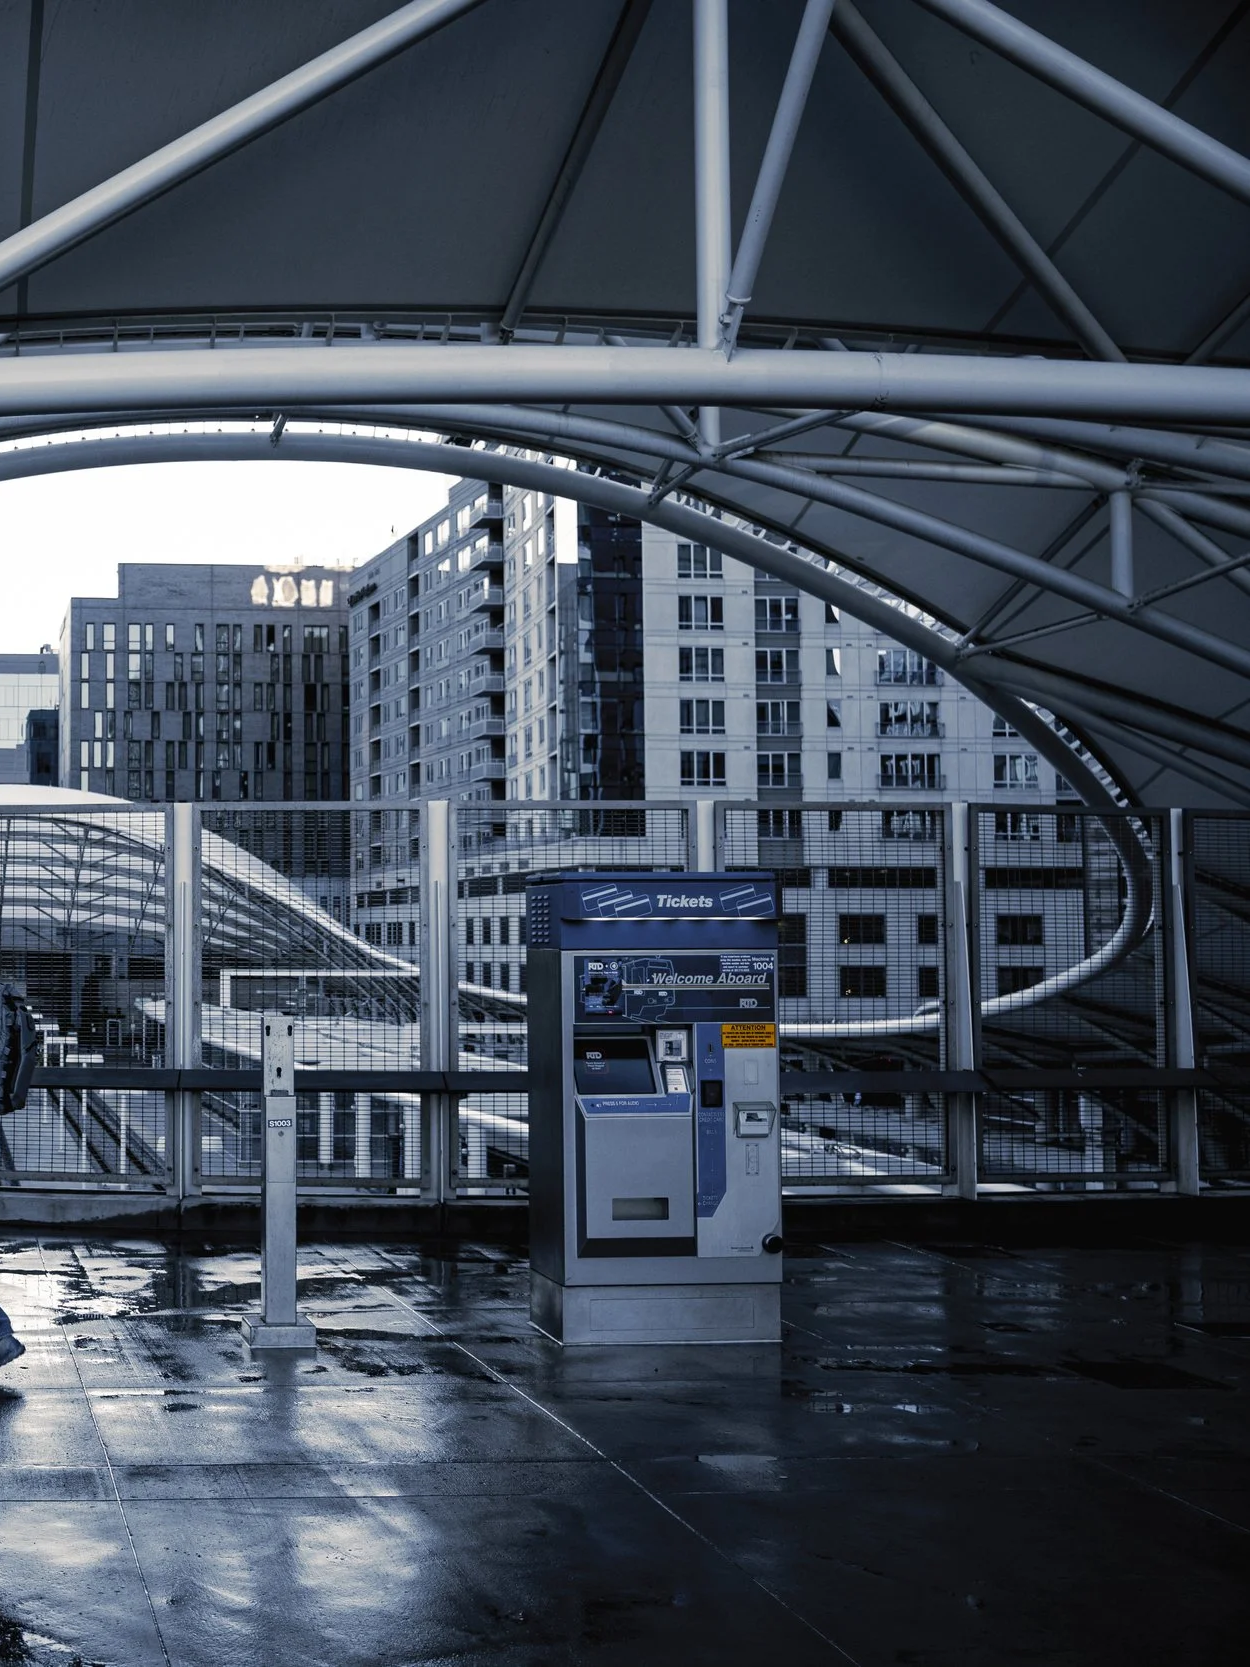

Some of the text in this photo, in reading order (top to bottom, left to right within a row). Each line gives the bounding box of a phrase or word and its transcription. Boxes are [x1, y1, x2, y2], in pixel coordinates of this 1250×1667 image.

[656, 894, 714, 908] Tickets
[588, 962, 604, 971] RTD
[752, 961, 774, 970] 1004
[652, 972, 767, 984] Welcome Aboard
[739, 998, 758, 1008] RTD
[585, 1051, 602, 1060] RTD
